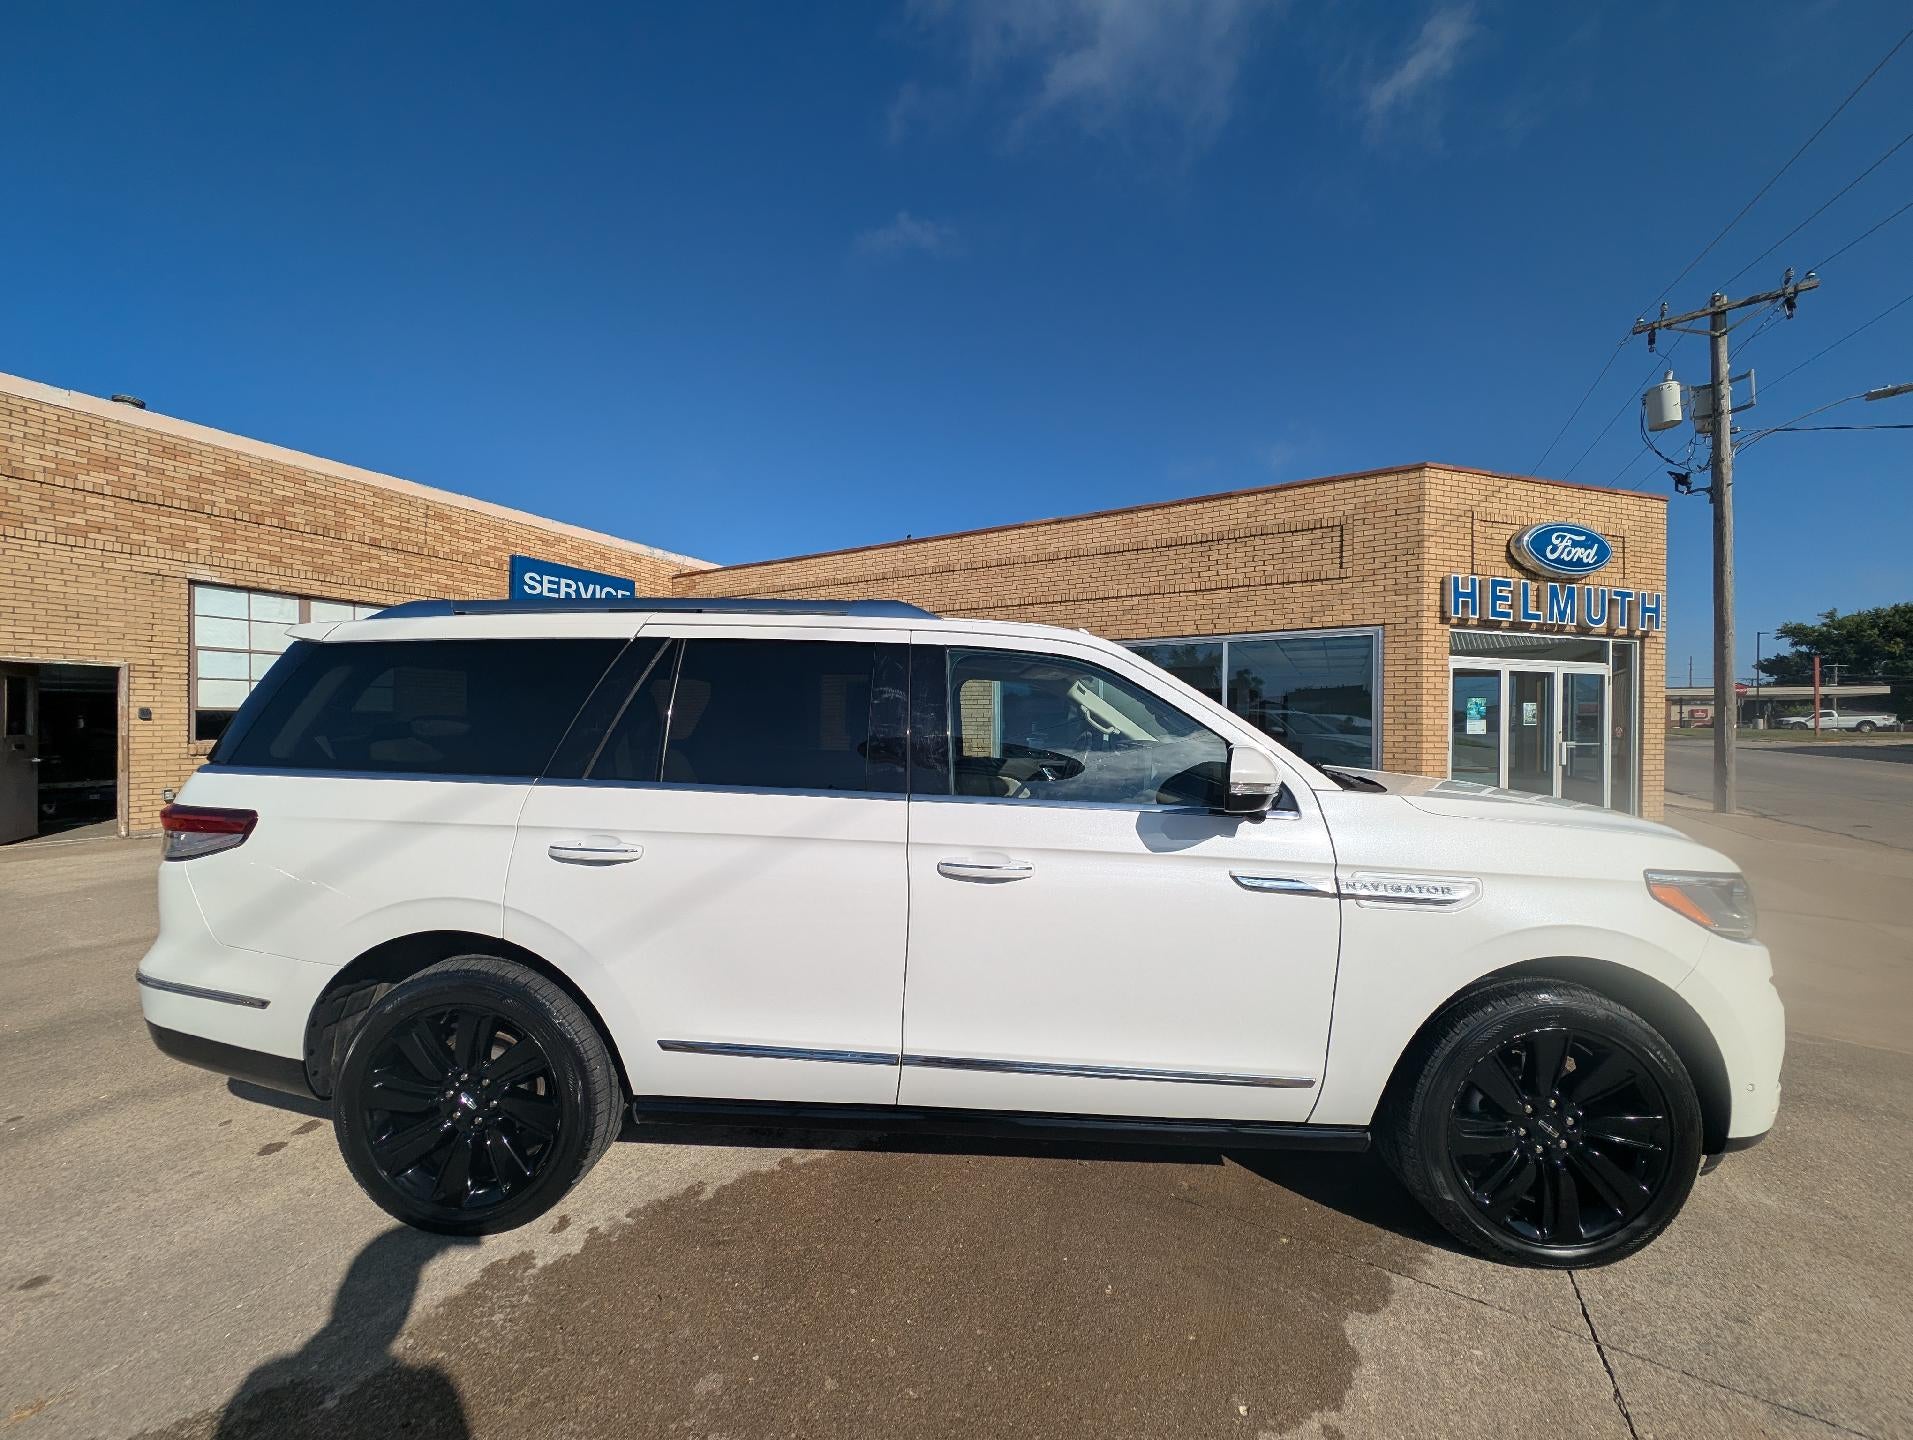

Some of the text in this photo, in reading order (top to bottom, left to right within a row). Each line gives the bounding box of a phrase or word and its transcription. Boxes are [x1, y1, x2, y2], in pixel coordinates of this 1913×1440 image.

[1545, 531, 1599, 564] Ford
[1450, 574, 1662, 631] HELMUTH
[1345, 881, 1453, 896] NAVIGATOR
